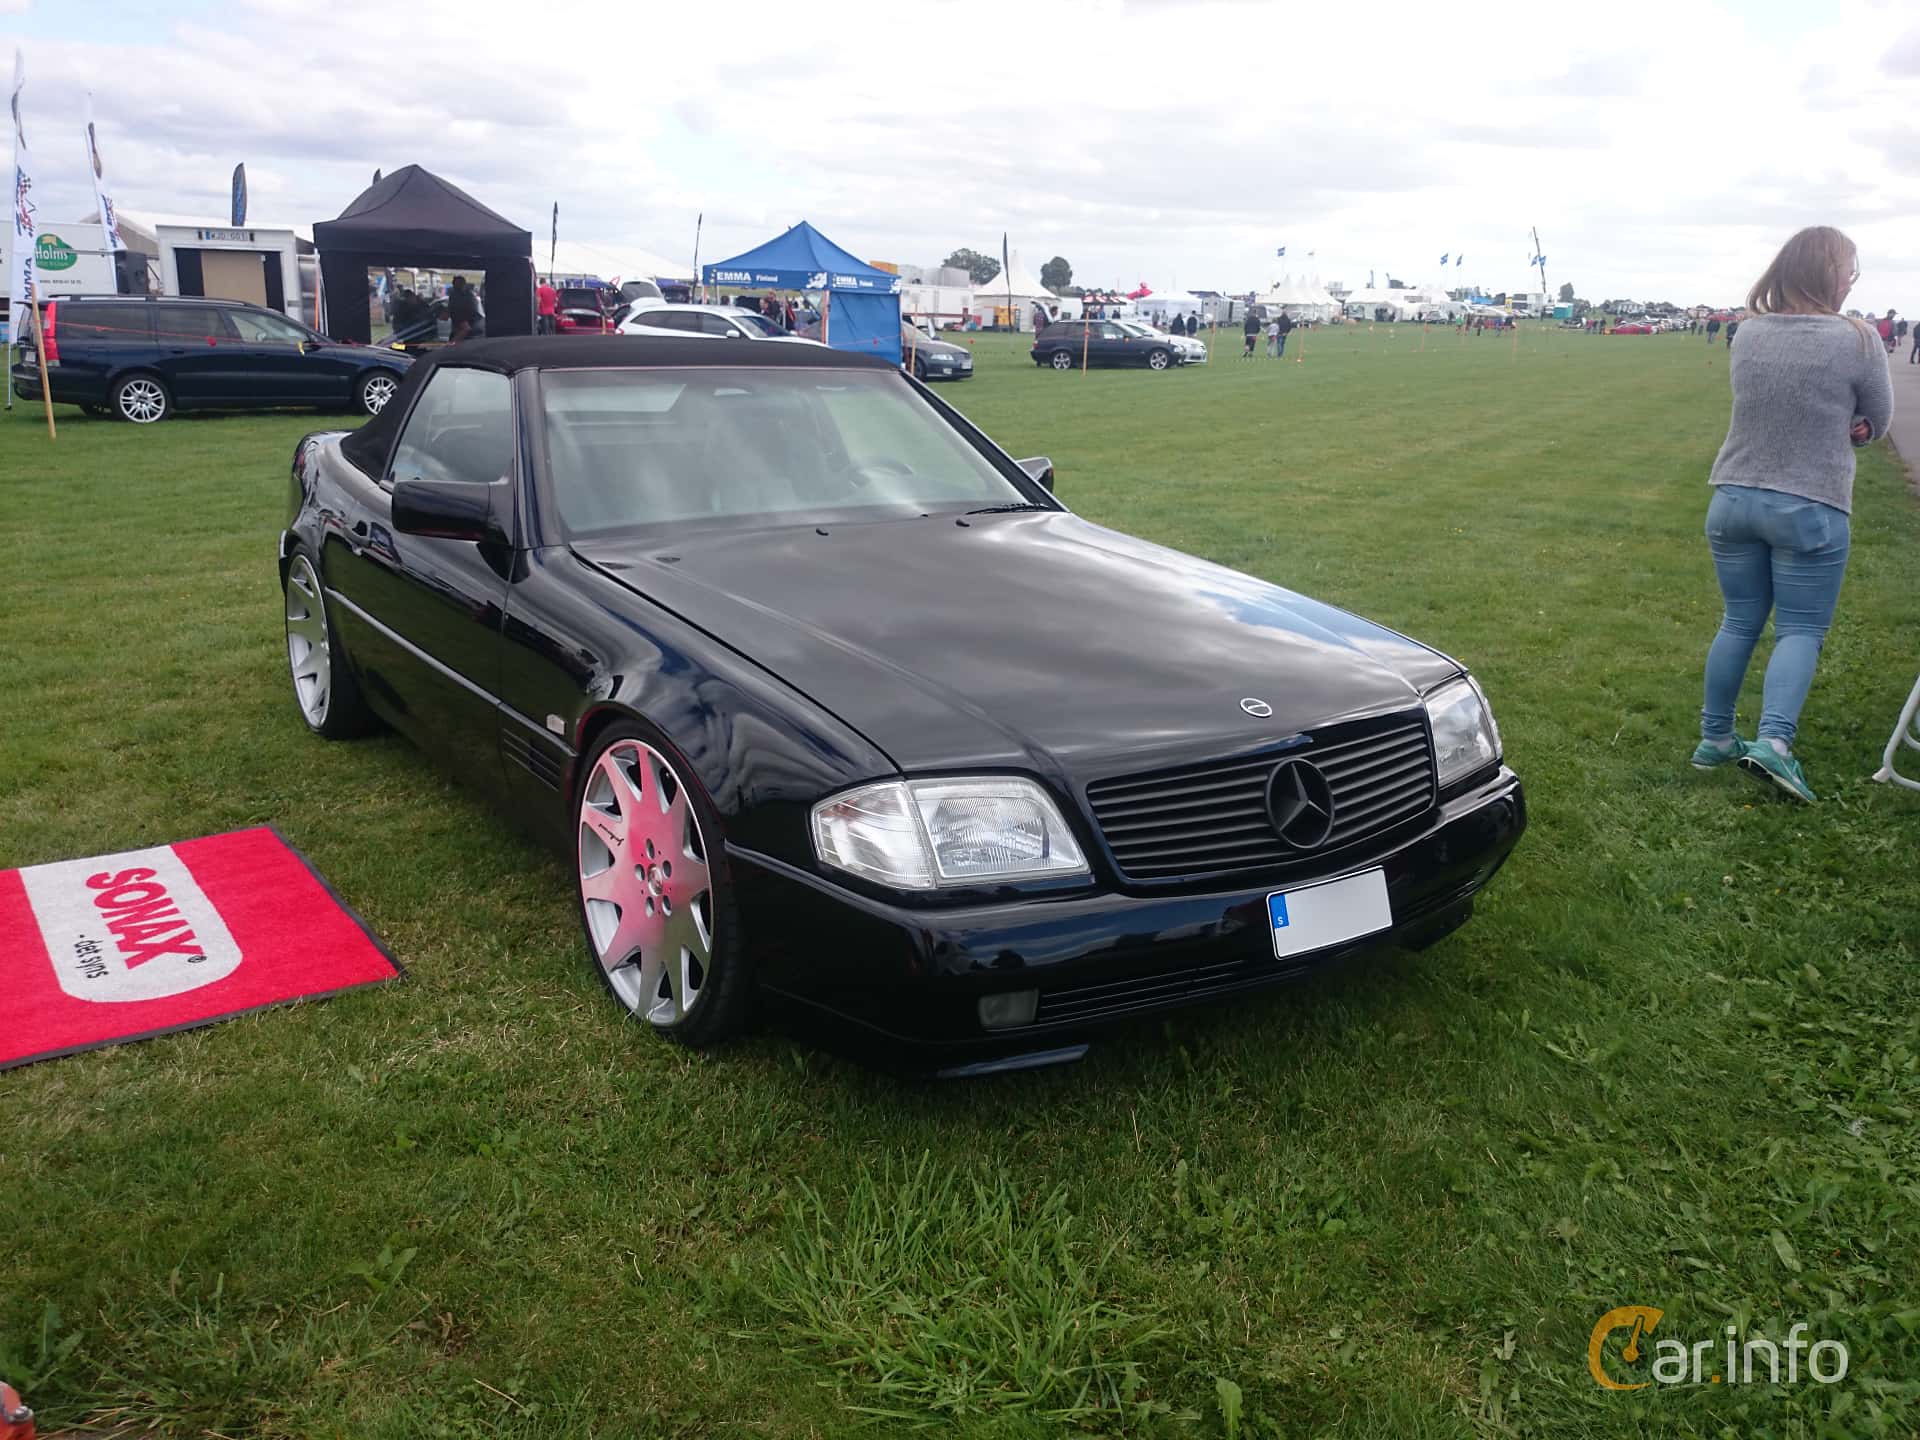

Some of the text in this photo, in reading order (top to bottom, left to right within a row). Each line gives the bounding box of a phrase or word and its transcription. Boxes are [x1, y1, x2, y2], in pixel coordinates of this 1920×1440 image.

[35, 244, 68, 260] Holms
[23, 257, 33, 301] MMA
[716, 271, 752, 281] EMMA
[836, 276, 858, 286] EMMA
[1277, 916, 1284, 926] S
[74, 940, 103, 958] det
[75, 955, 109, 979] syns
